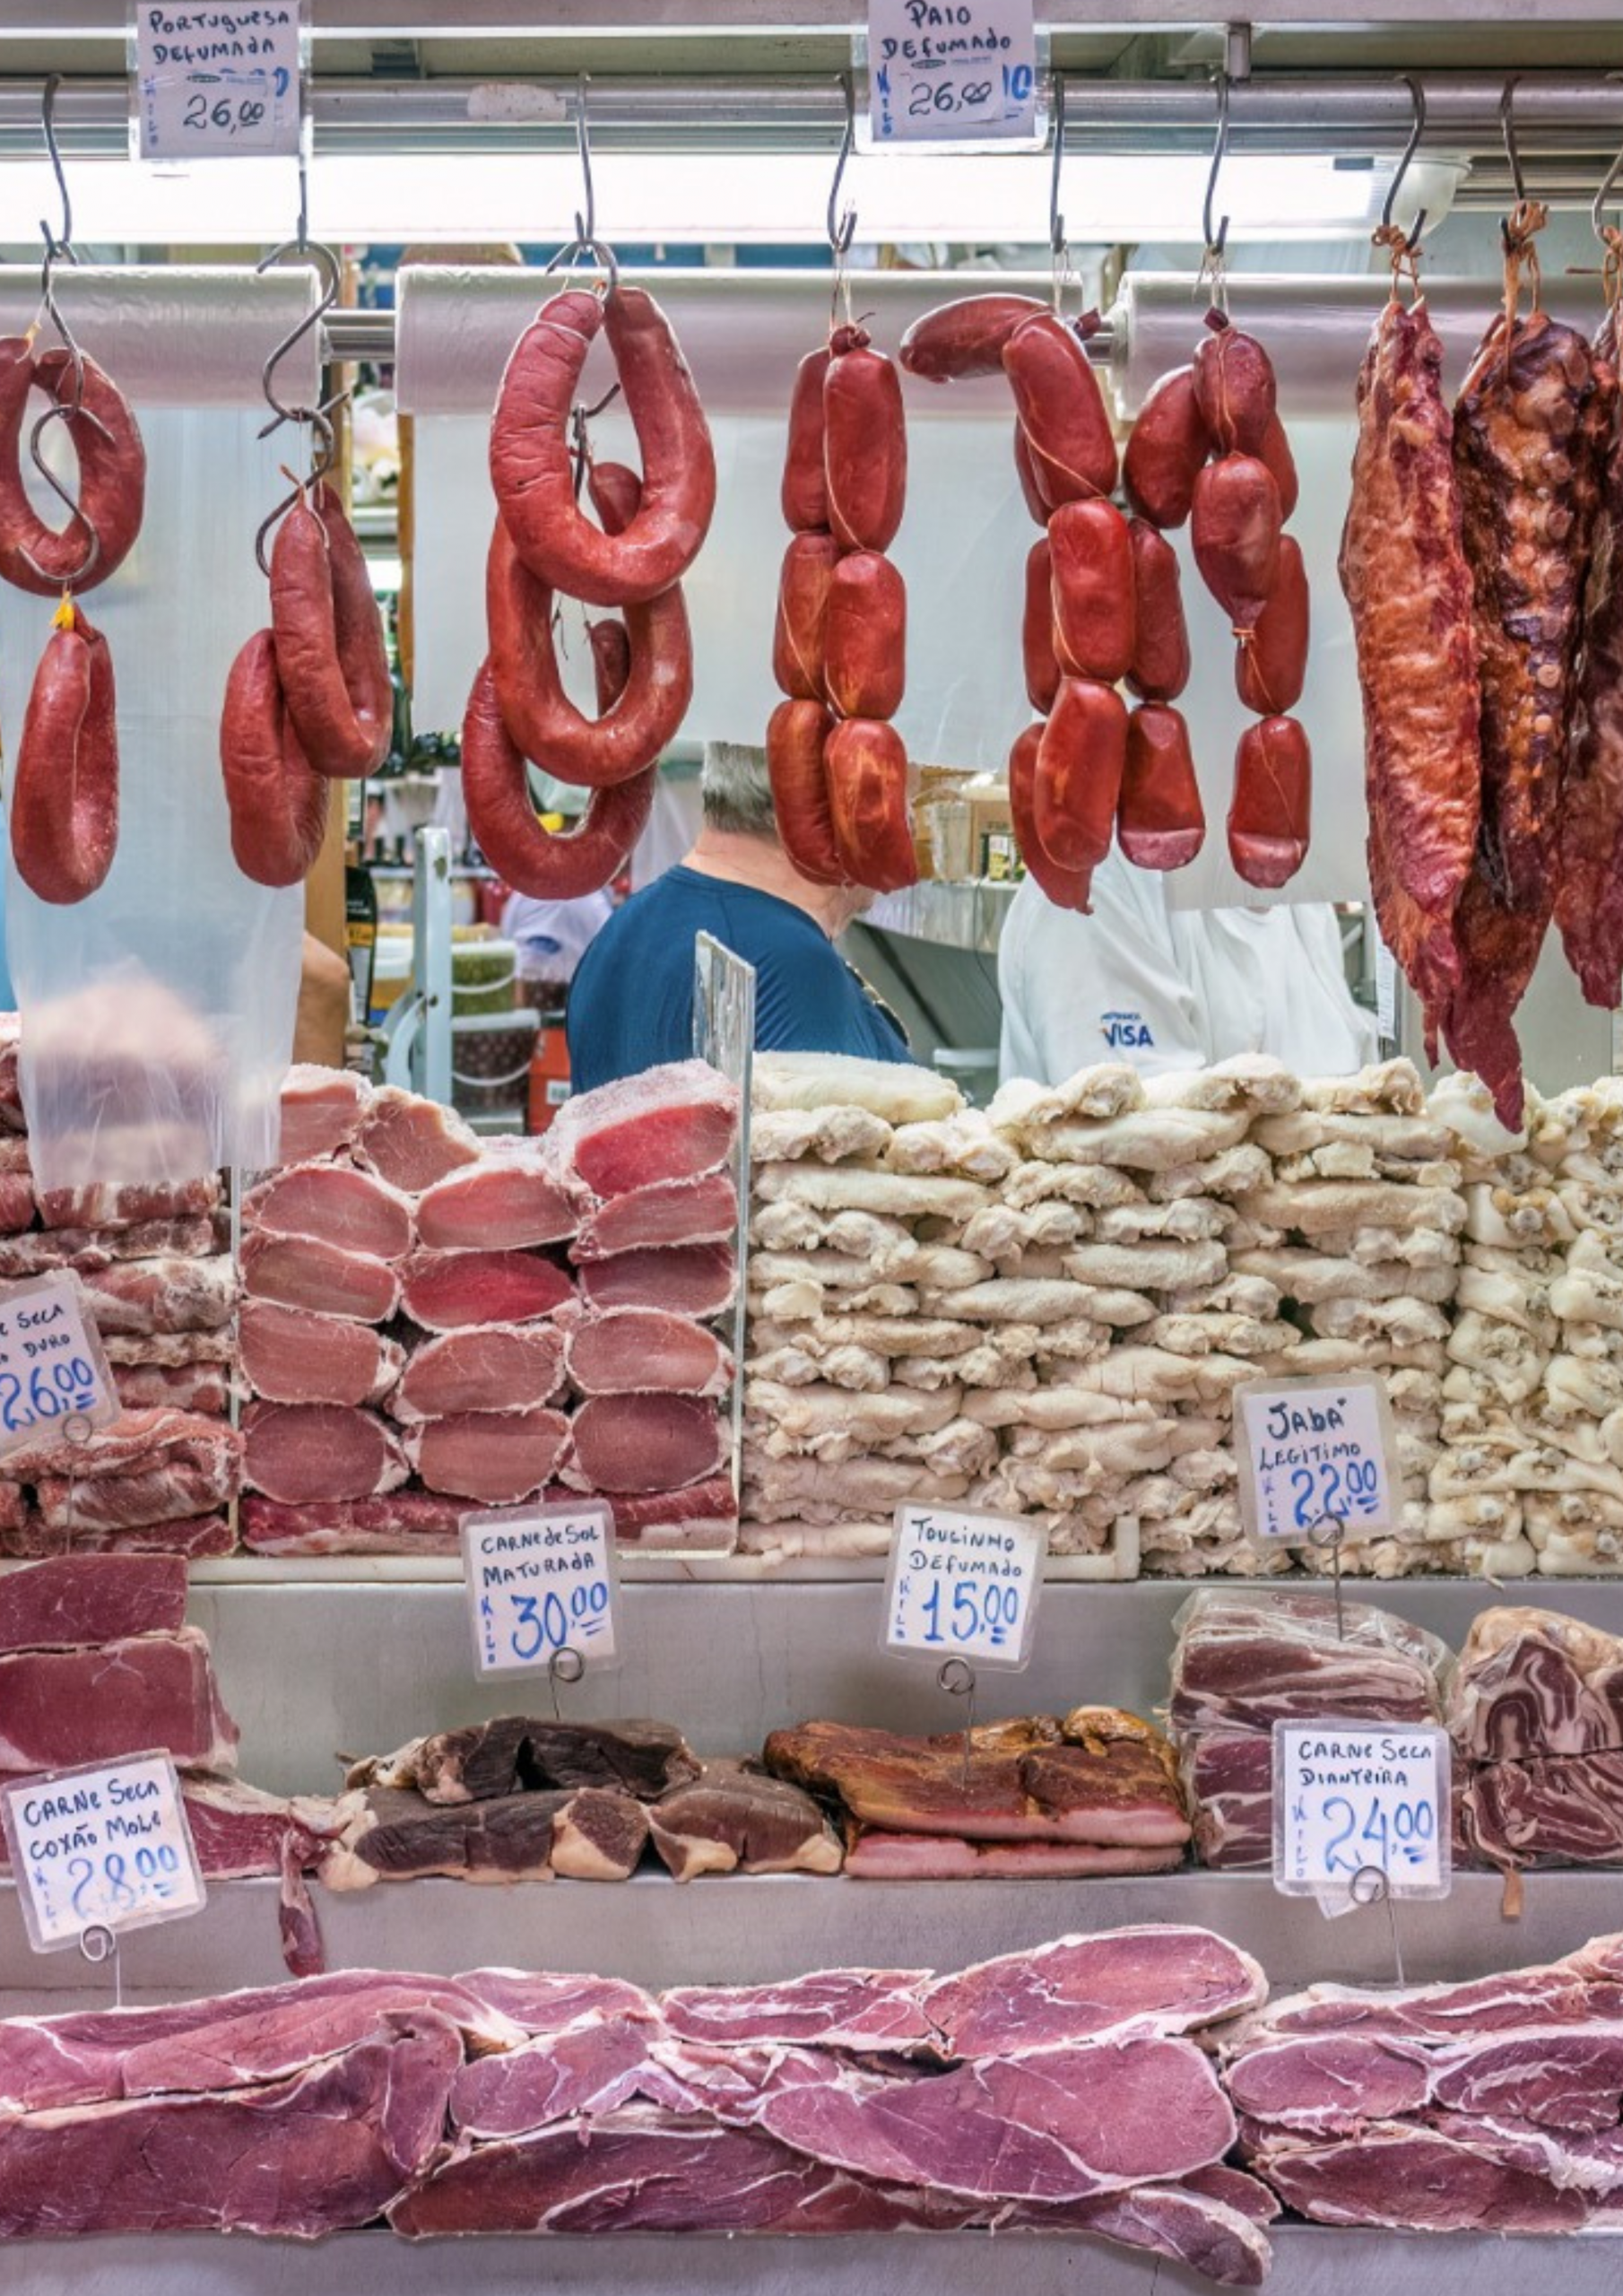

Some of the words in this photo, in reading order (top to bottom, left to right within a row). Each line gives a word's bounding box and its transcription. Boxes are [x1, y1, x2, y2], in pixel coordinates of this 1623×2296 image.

[905, 0, 972, 29] PAIO
[183, 93, 265, 134] 26,00
[1101, 1022, 1154, 1048] VISA
